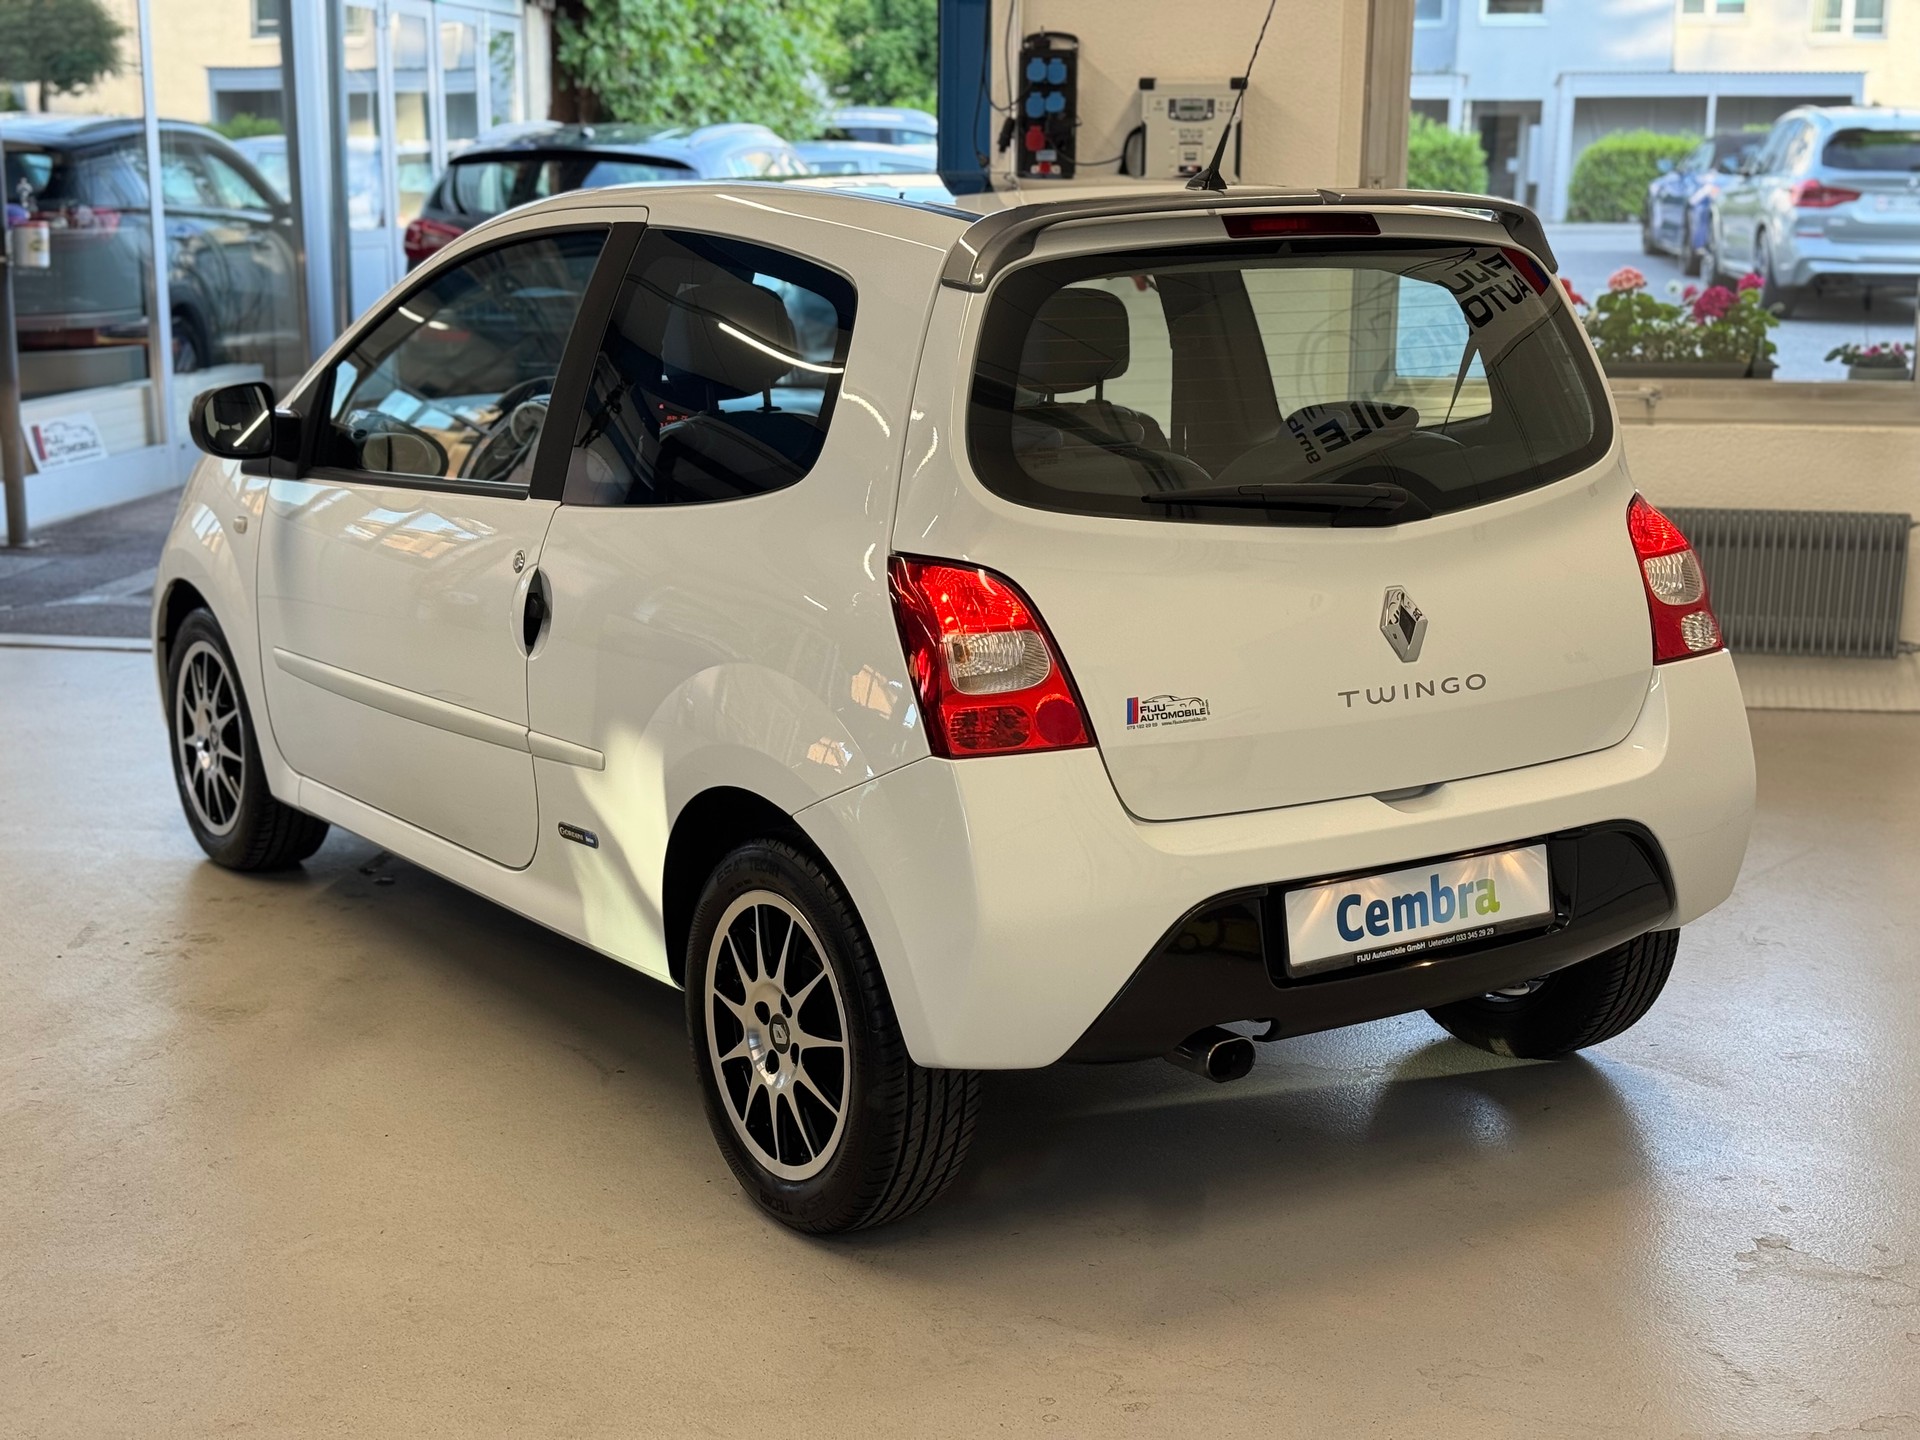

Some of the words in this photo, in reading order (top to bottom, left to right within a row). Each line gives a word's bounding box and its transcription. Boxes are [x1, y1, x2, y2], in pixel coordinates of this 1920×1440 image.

[1338, 673, 1487, 708] TWINGO
[1140, 704, 1165, 714] FIJU
[1140, 708, 1206, 722] AUTOMOBILE
[1336, 873, 1501, 942] Cembra
[1356, 953, 1371, 963] FIJU
[1372, 946, 1406, 960] Automobile
[1406, 941, 1426, 952] GmbH
[1428, 935, 1456, 948] Uetendorf
[1456, 932, 1467, 941] 033
[1467, 930, 1478, 940] 345
